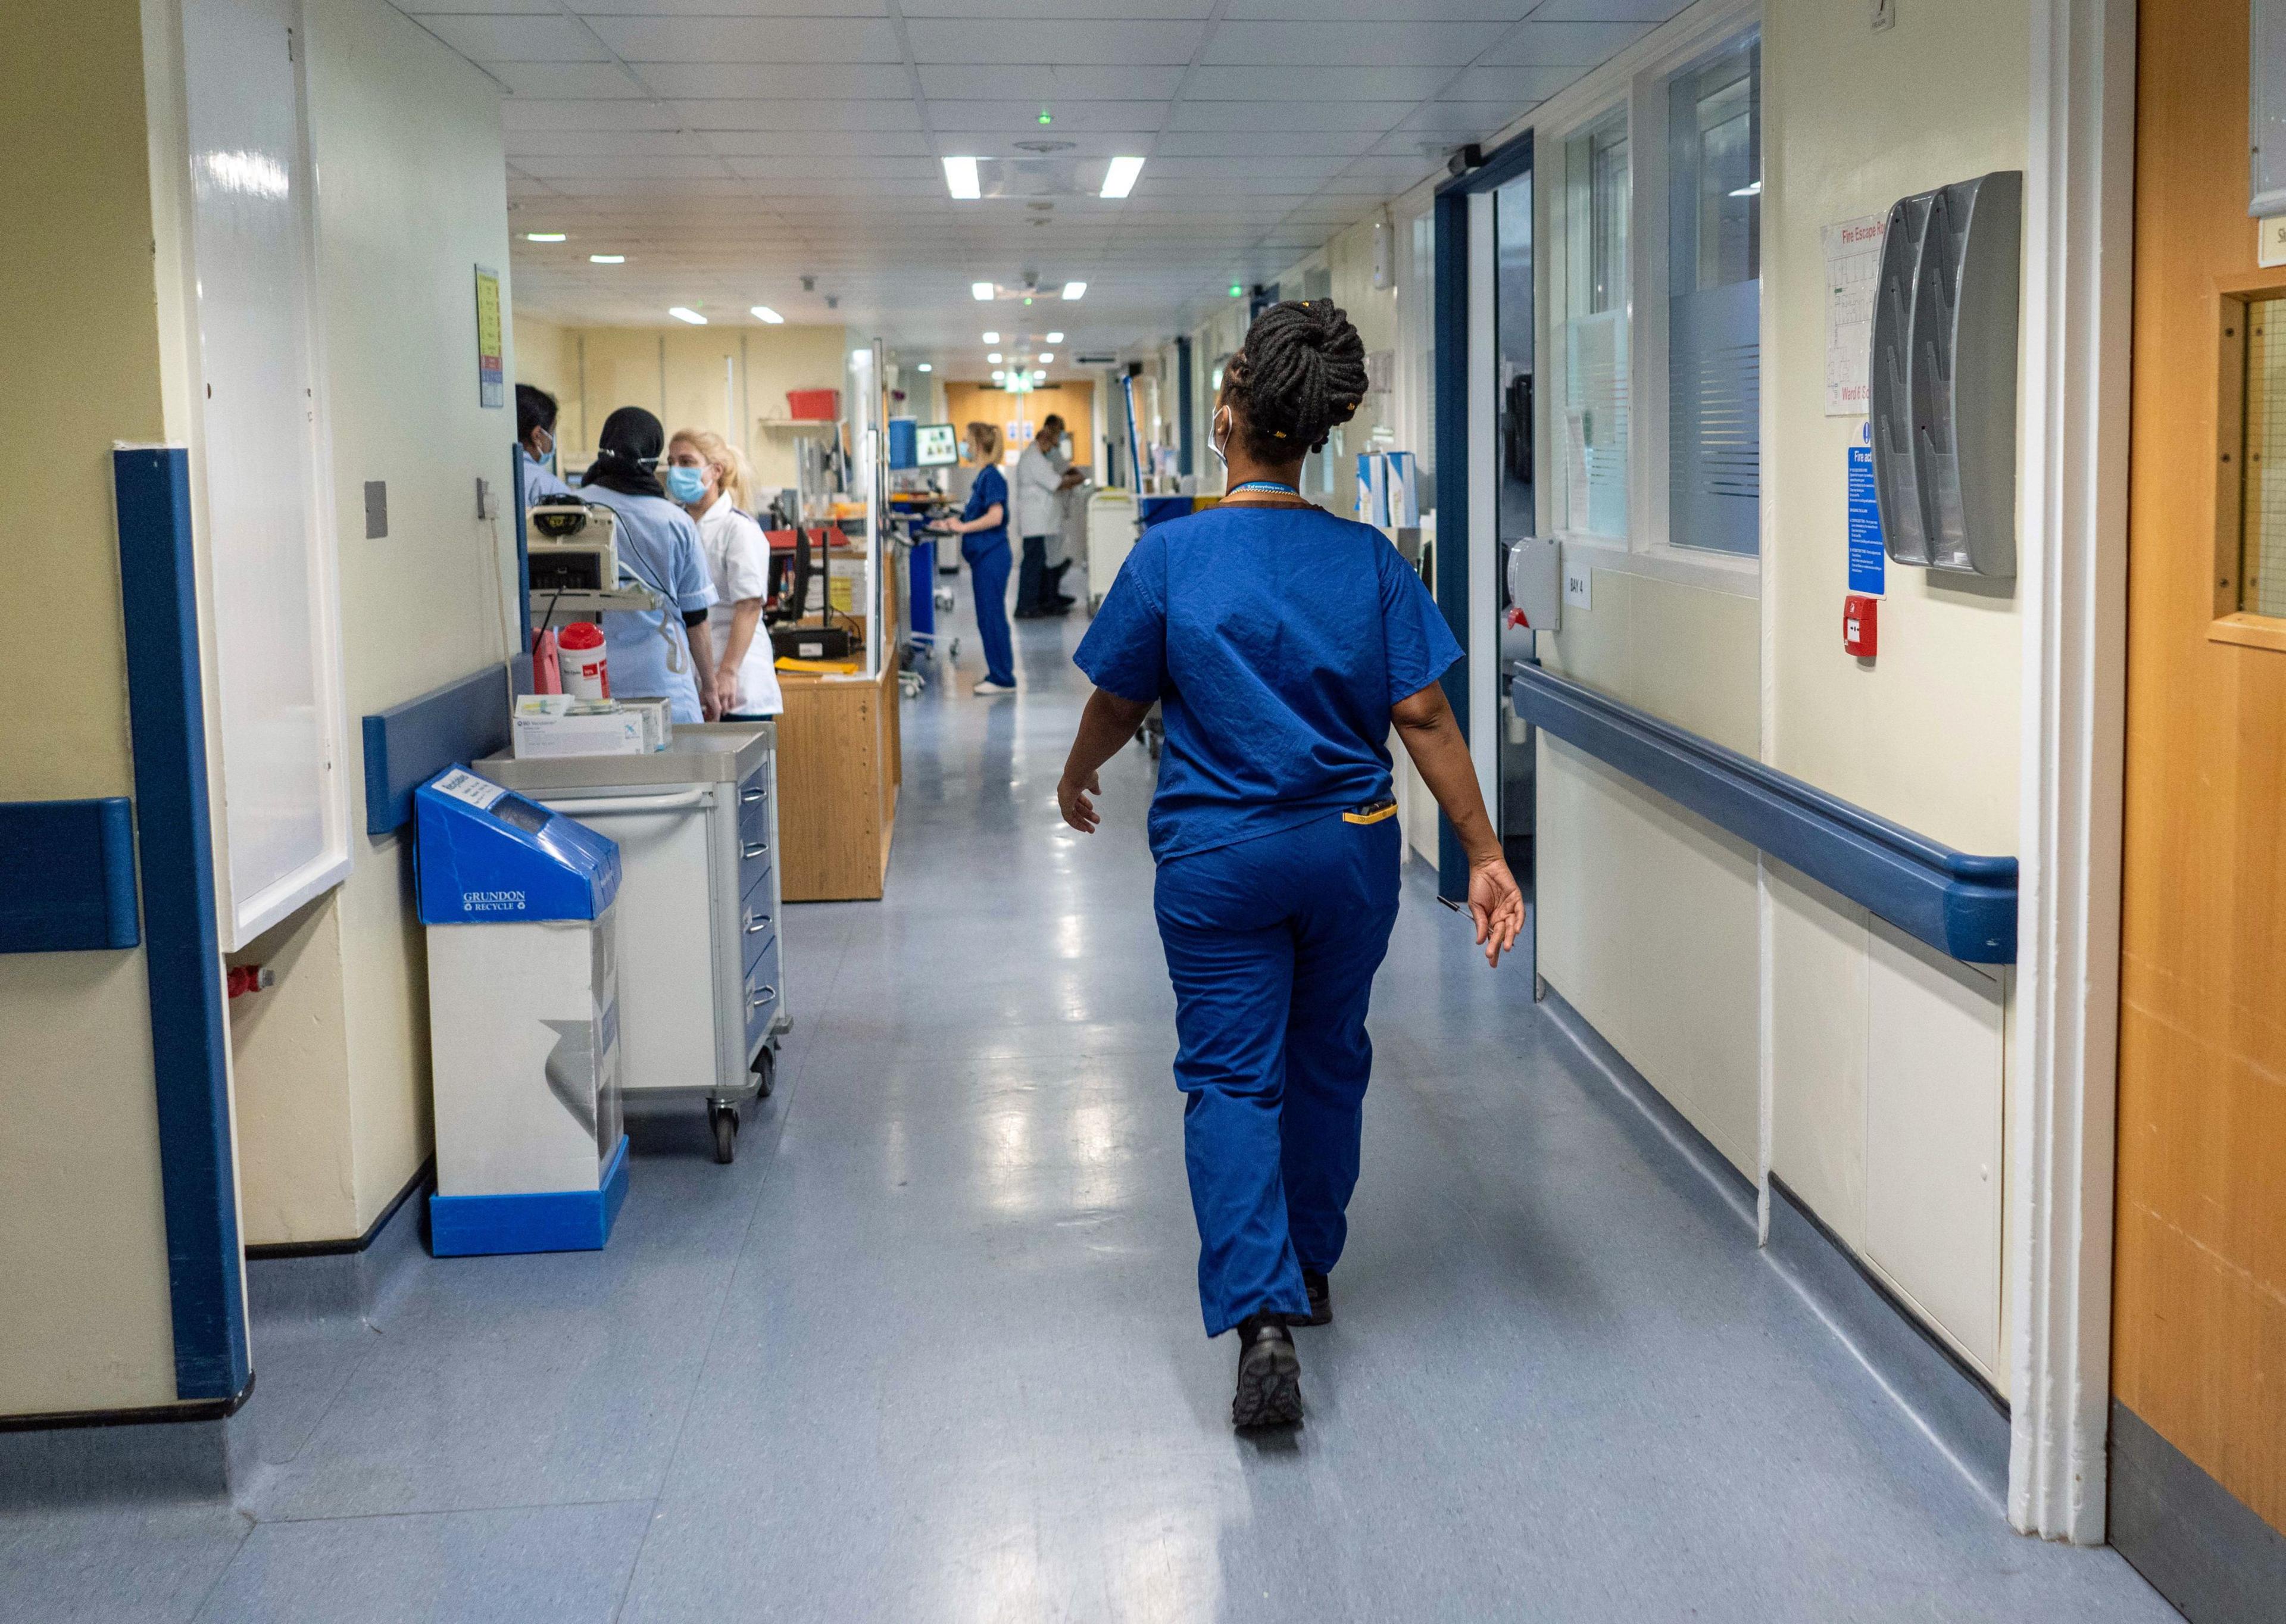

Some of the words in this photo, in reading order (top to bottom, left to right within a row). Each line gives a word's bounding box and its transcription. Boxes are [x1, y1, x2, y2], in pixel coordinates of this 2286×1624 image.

[1842, 229, 1854, 244] Fire
[1855, 226, 1876, 241] Escape
[1842, 386, 1856, 400] Ward
[1857, 386, 1861, 399] 6
[1854, 450, 1864, 463] Fire
[1570, 577, 1579, 593] BAY
[1579, 580, 1583, 594] 4
[463, 891, 525, 901] GRUNDON
[475, 902, 514, 911] RECYCLE
